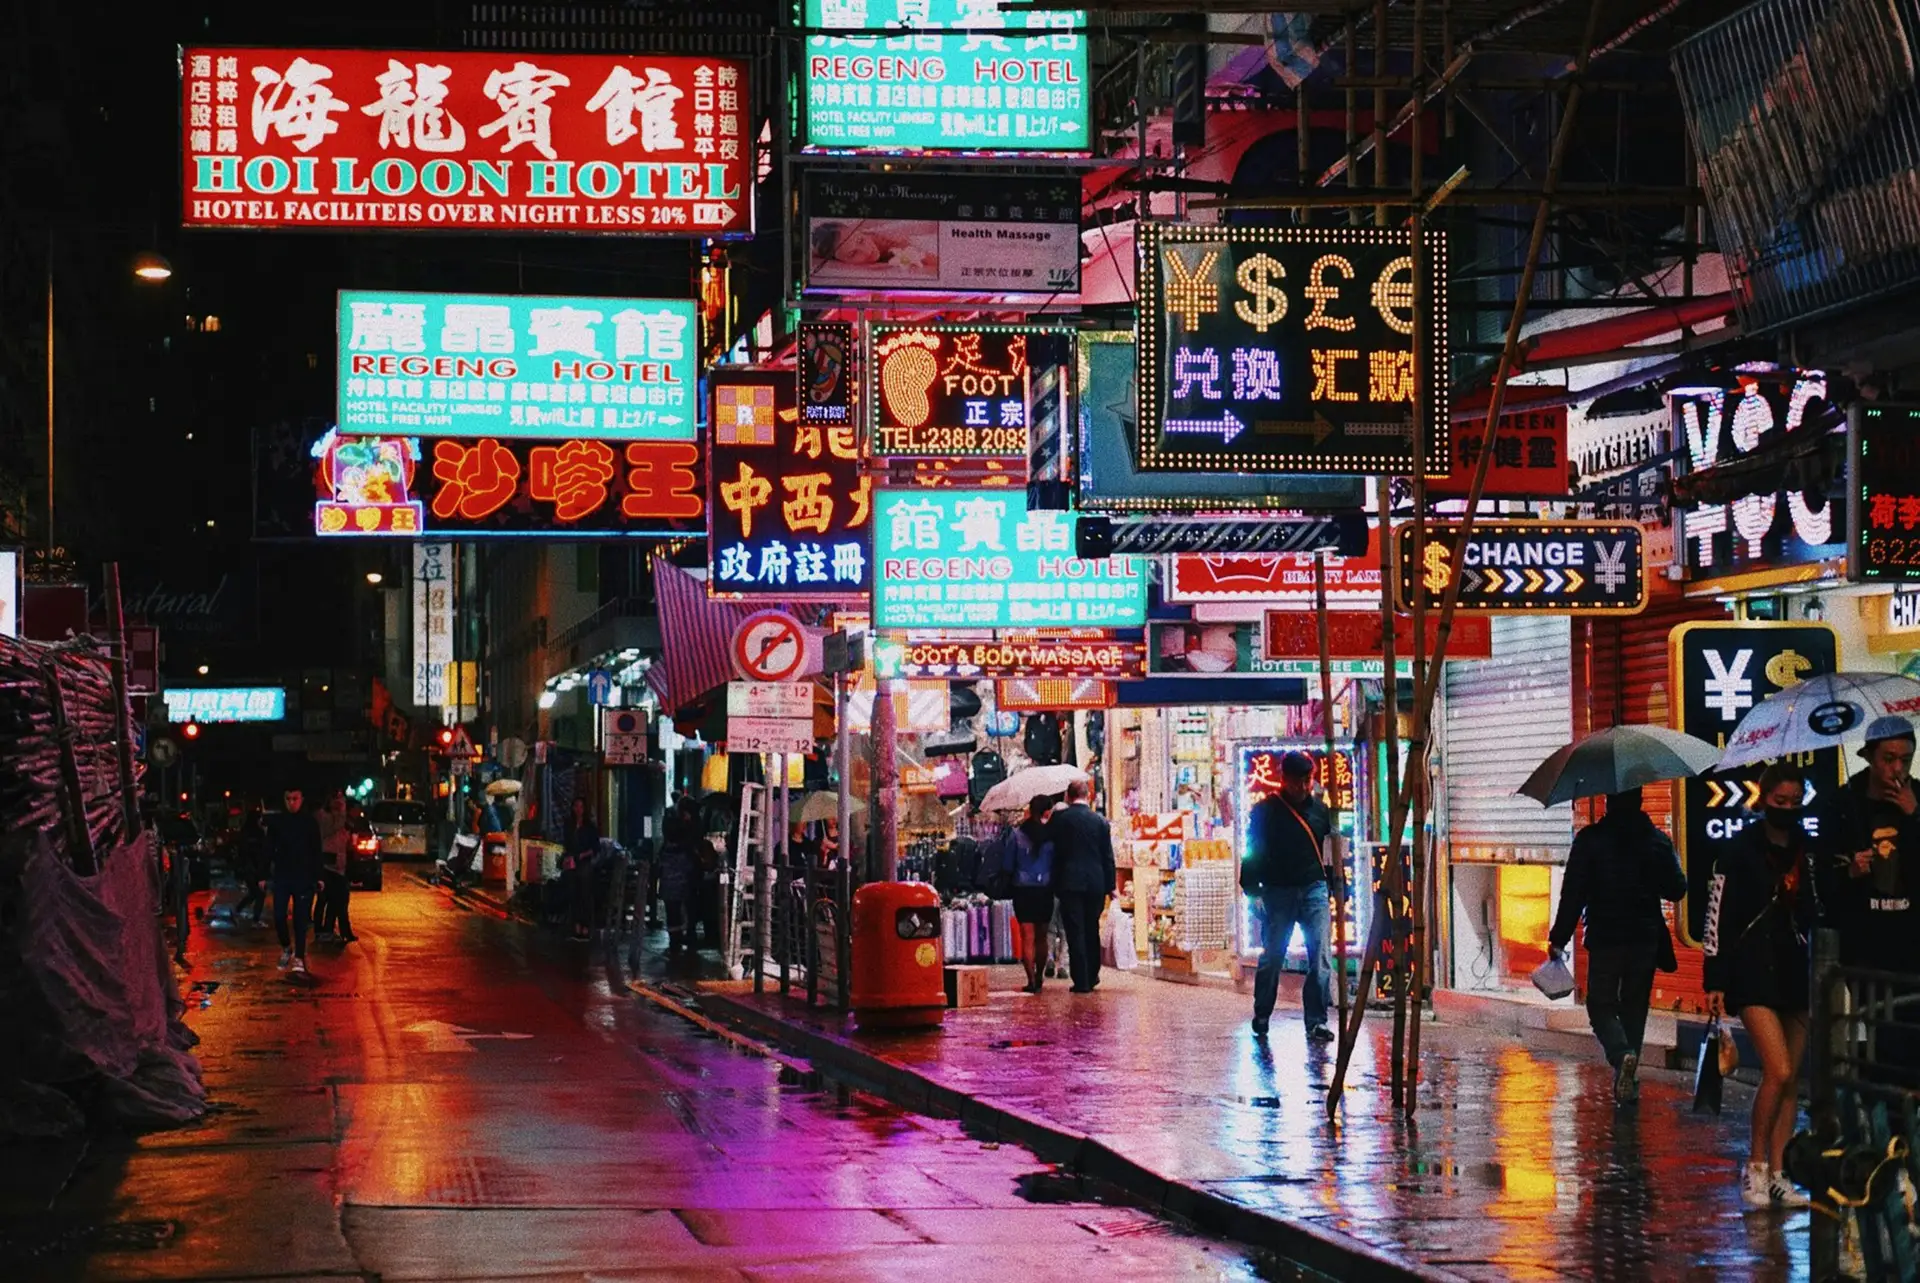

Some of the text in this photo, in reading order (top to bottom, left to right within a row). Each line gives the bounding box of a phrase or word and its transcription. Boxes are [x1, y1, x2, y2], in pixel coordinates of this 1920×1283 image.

[810, 56, 1080, 83] REGENG HOTEL
[251, 57, 684, 160] 海龍賓館
[811, 112, 844, 123] HOTEL
[847, 112, 891, 124] FACILITY
[811, 126, 845, 137] HOTEL
[847, 126, 870, 138] FREE
[192, 156, 741, 200] HOI LOON HOTEL
[890, 185, 956, 204] Massage
[193, 200, 278, 220] HOTEL
[284, 201, 422, 221] FACILITEIS
[428, 203, 494, 223] OVER
[500, 204, 581, 224] NIGHT
[586, 205, 646, 224] LESS
[651, 206, 687, 224] 20%
[951, 228, 1051, 241] Health Massage
[351, 354, 683, 384] REGENG HOTEL
[943, 375, 1015, 396] FOOT
[347, 401, 388, 412] HOTEL
[392, 402, 448, 413] FACILITY
[806, 406, 823, 418] FOOT
[829, 406, 846, 418] BODY
[347, 413, 388, 424] HOTEL
[392, 414, 421, 425] FREE
[879, 427, 976, 450] TEL:2388
[719, 540, 866, 584] 政府註冊
[1463, 542, 1584, 566] CHANGE
[884, 557, 1138, 580] REGENG HOTEL
[1282, 570, 1343, 584] BEATY
[902, 646, 1123, 665] FOOT & BODY MASSAGE
[1250, 660, 1302, 672] HOTEL
[1312, 660, 1351, 672] FEE
[794, 686, 808, 698] 12
[746, 738, 760, 749] 12
[795, 739, 810, 751] 12
[632, 754, 645, 764] 12
[1706, 817, 1819, 839] CHE
